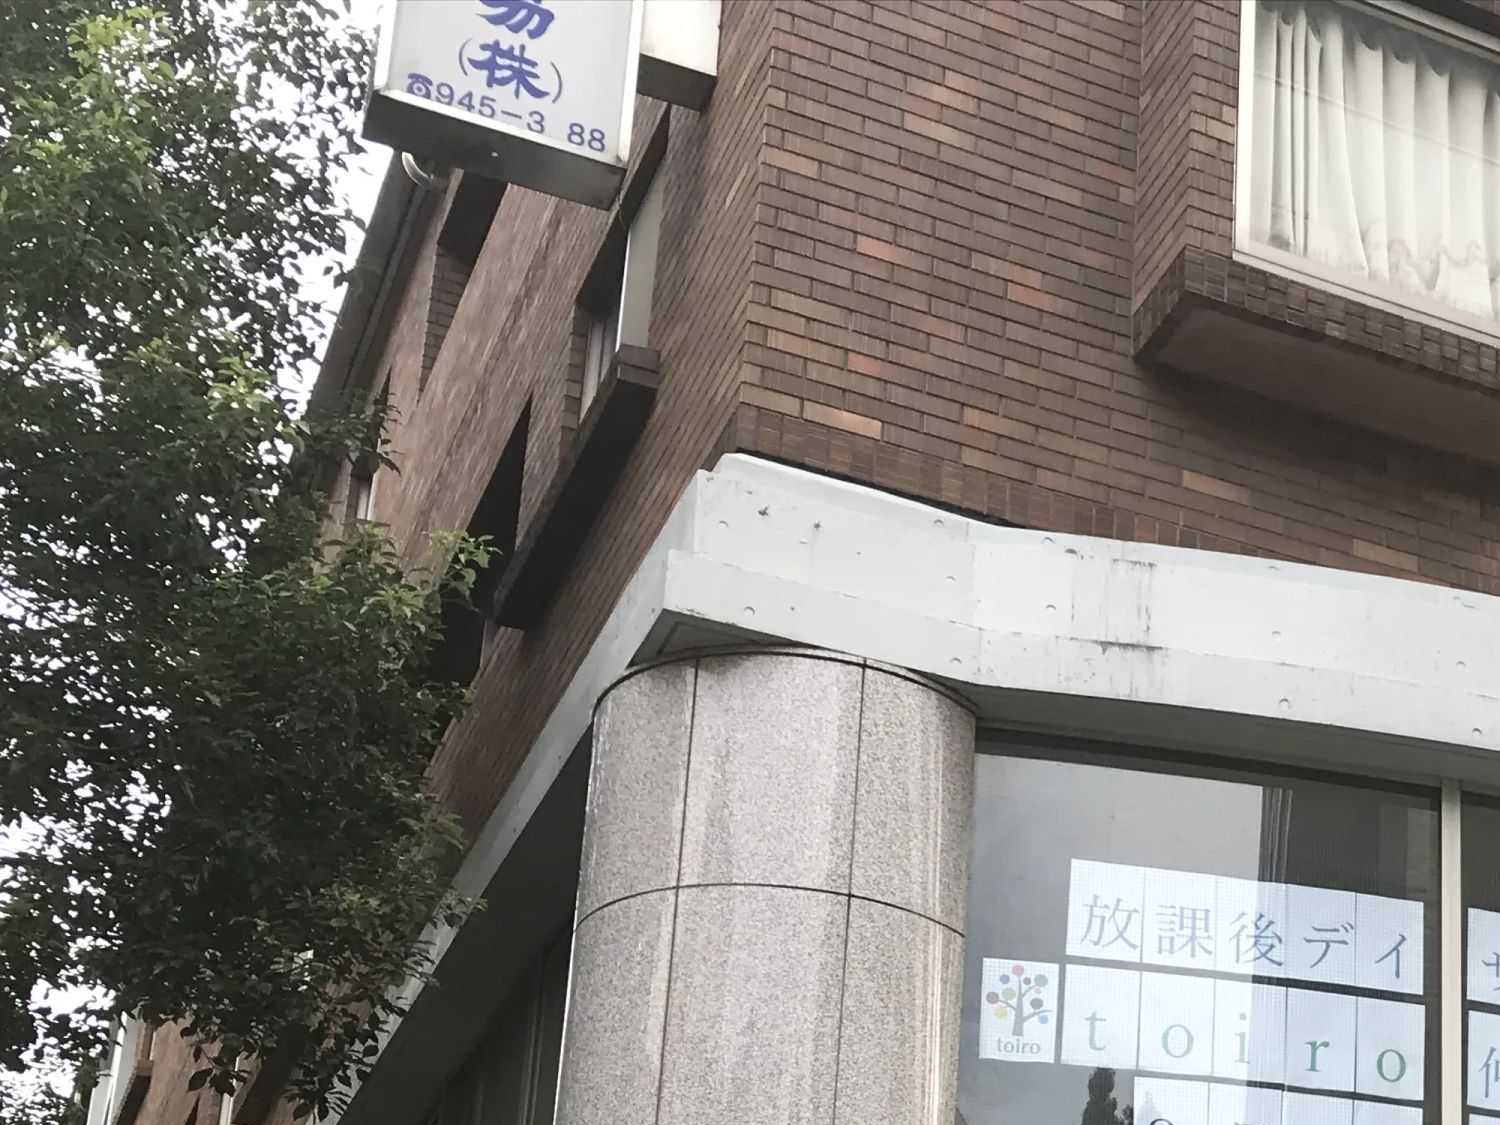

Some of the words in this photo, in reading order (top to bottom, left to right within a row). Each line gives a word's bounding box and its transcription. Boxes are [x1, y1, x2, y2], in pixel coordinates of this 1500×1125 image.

[435, 82, 607, 152] 945-388
[996, 1037, 1041, 1055] toiro
[1085, 1010, 1406, 1082] toiro
